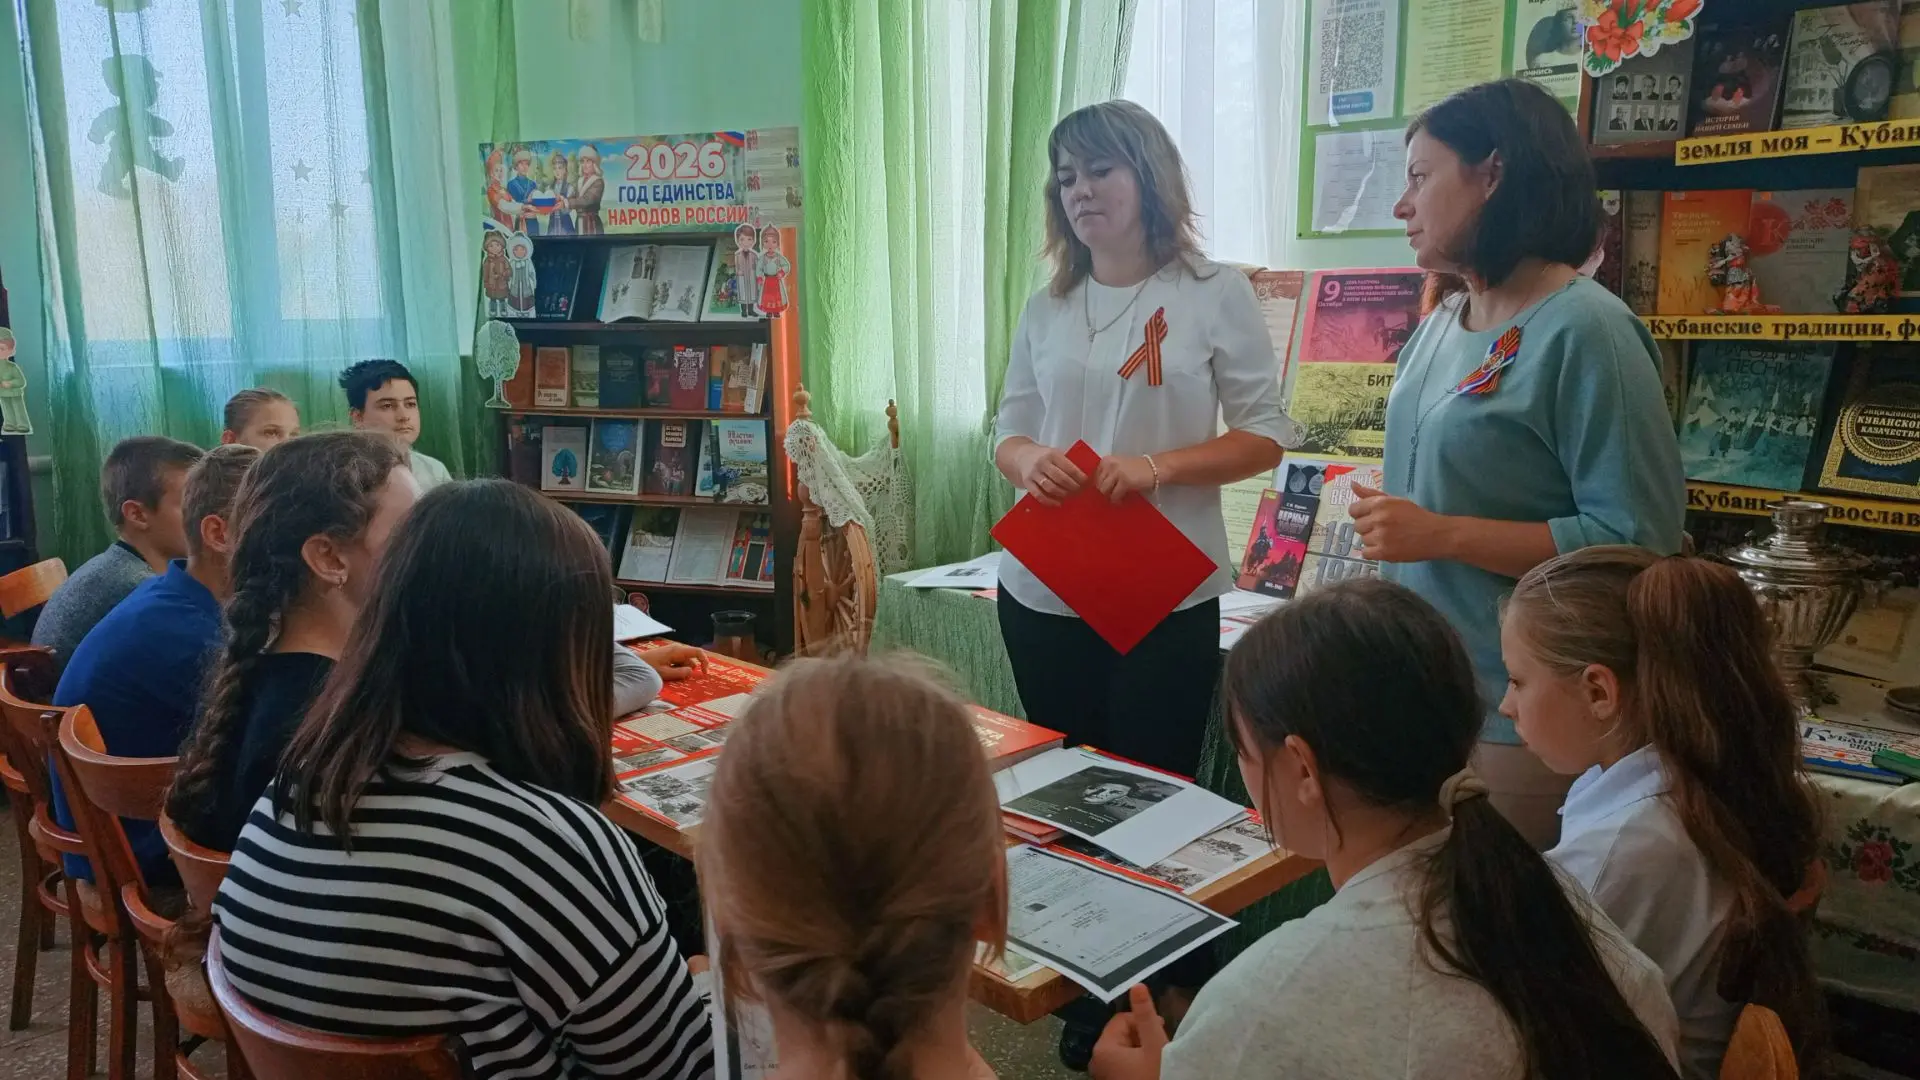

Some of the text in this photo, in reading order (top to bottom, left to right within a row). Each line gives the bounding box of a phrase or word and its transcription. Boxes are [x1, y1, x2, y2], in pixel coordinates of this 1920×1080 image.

[1723, 121, 1750, 130] СЕМЬИ
[1680, 140, 1752, 160] земля
[1761, 135, 1809, 153] моя
[624, 140, 726, 180] 2026
[618, 185, 648, 204] ГОД
[653, 183, 735, 204] ЕДИНСТВА
[608, 204, 748, 227] НАРОДОВ РОССИИ
[1324, 280, 1341, 302] 9
[1651, 318, 1920, 340] Кубанские традиции, ф
[1726, 358, 1793, 376] ПЕСНИ
[1367, 374, 1395, 387] БИТ
[1860, 425, 1920, 439] КАЗАЧЕСТВА
[1330, 489, 1360, 505] ВЕЧ
[1323, 521, 1362, 556] 19
